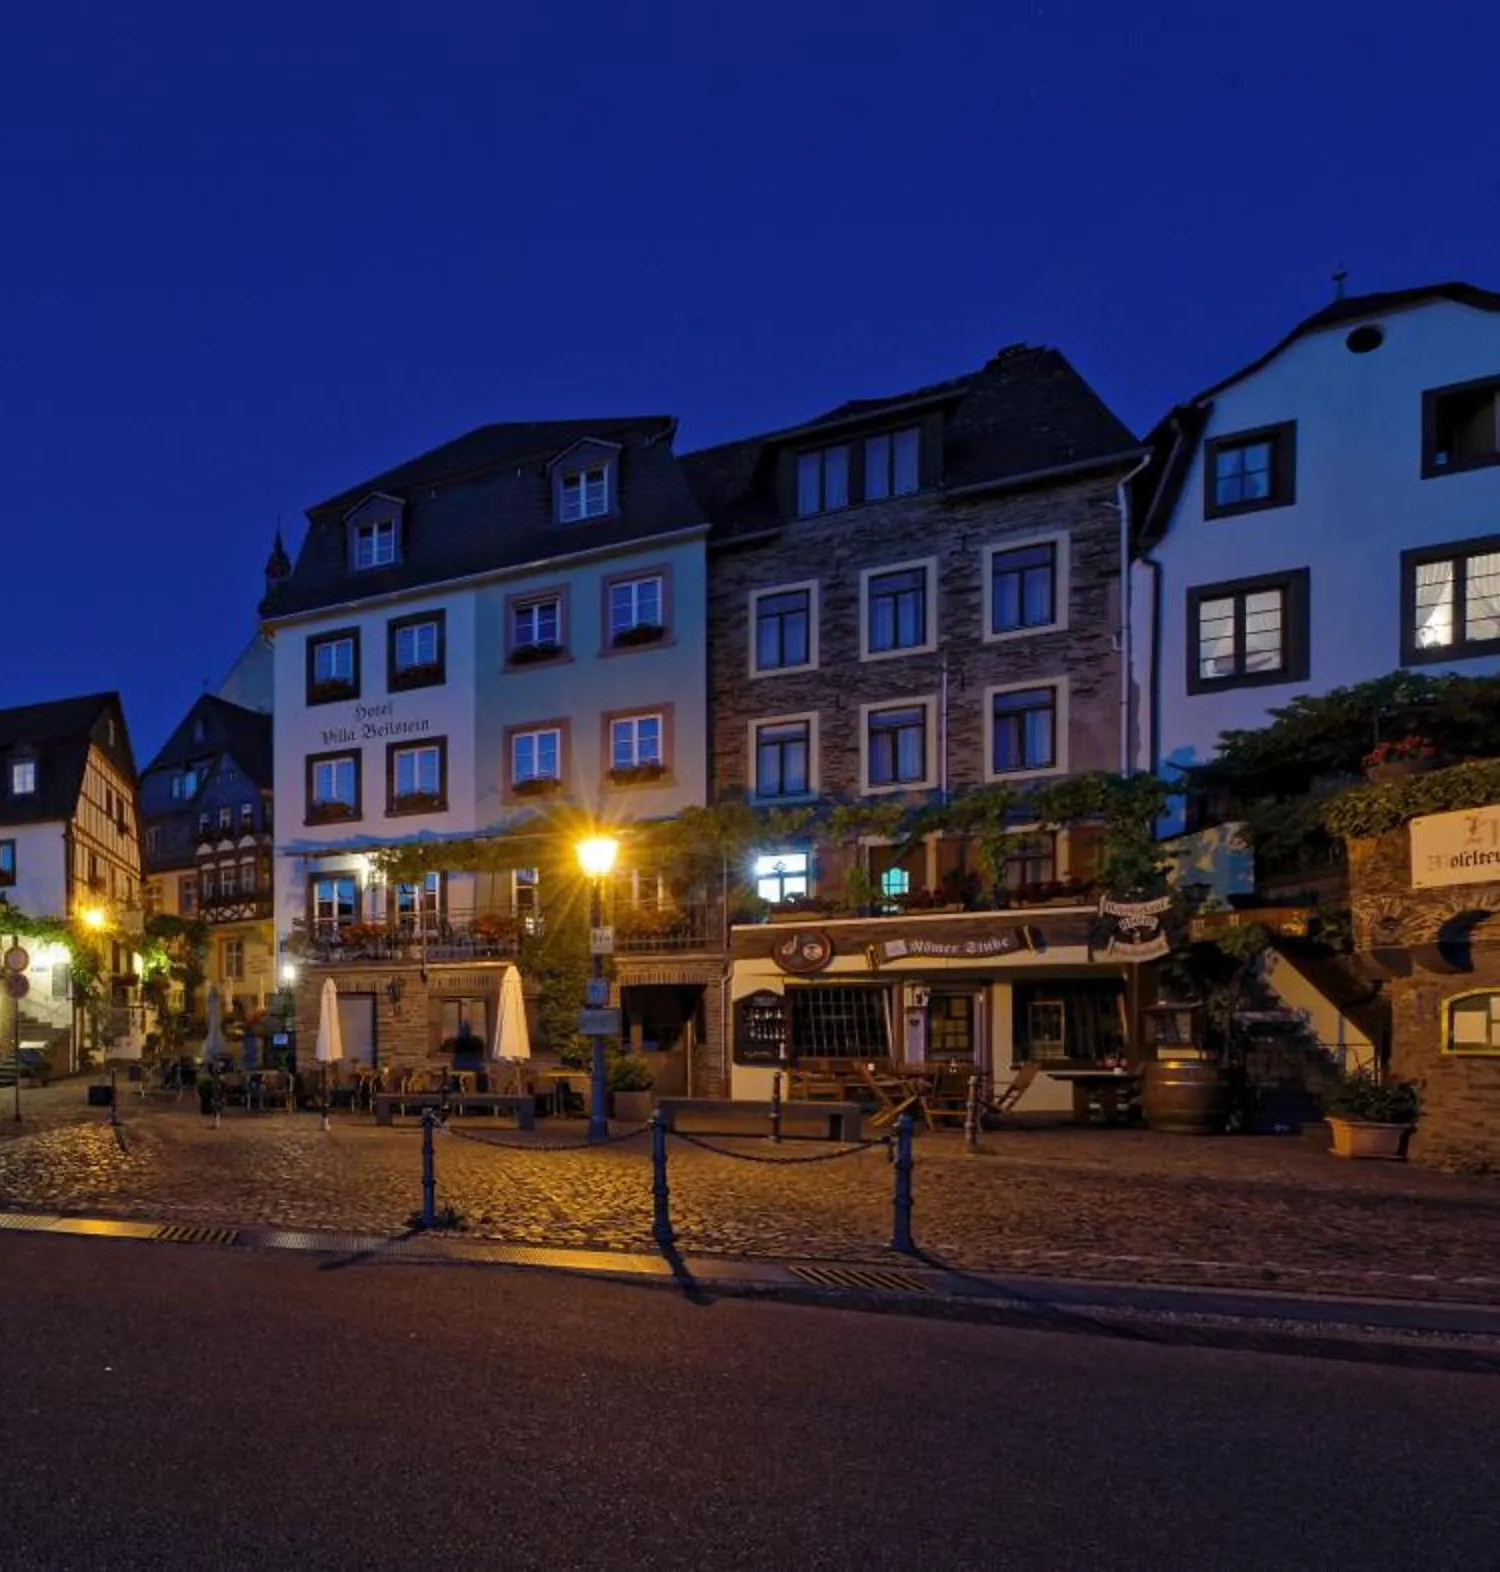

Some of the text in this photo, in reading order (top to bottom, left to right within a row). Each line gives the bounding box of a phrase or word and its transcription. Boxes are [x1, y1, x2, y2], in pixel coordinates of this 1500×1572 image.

[353, 701, 393, 719] Hotel
[322, 719, 430, 745] Villa Beilstein
